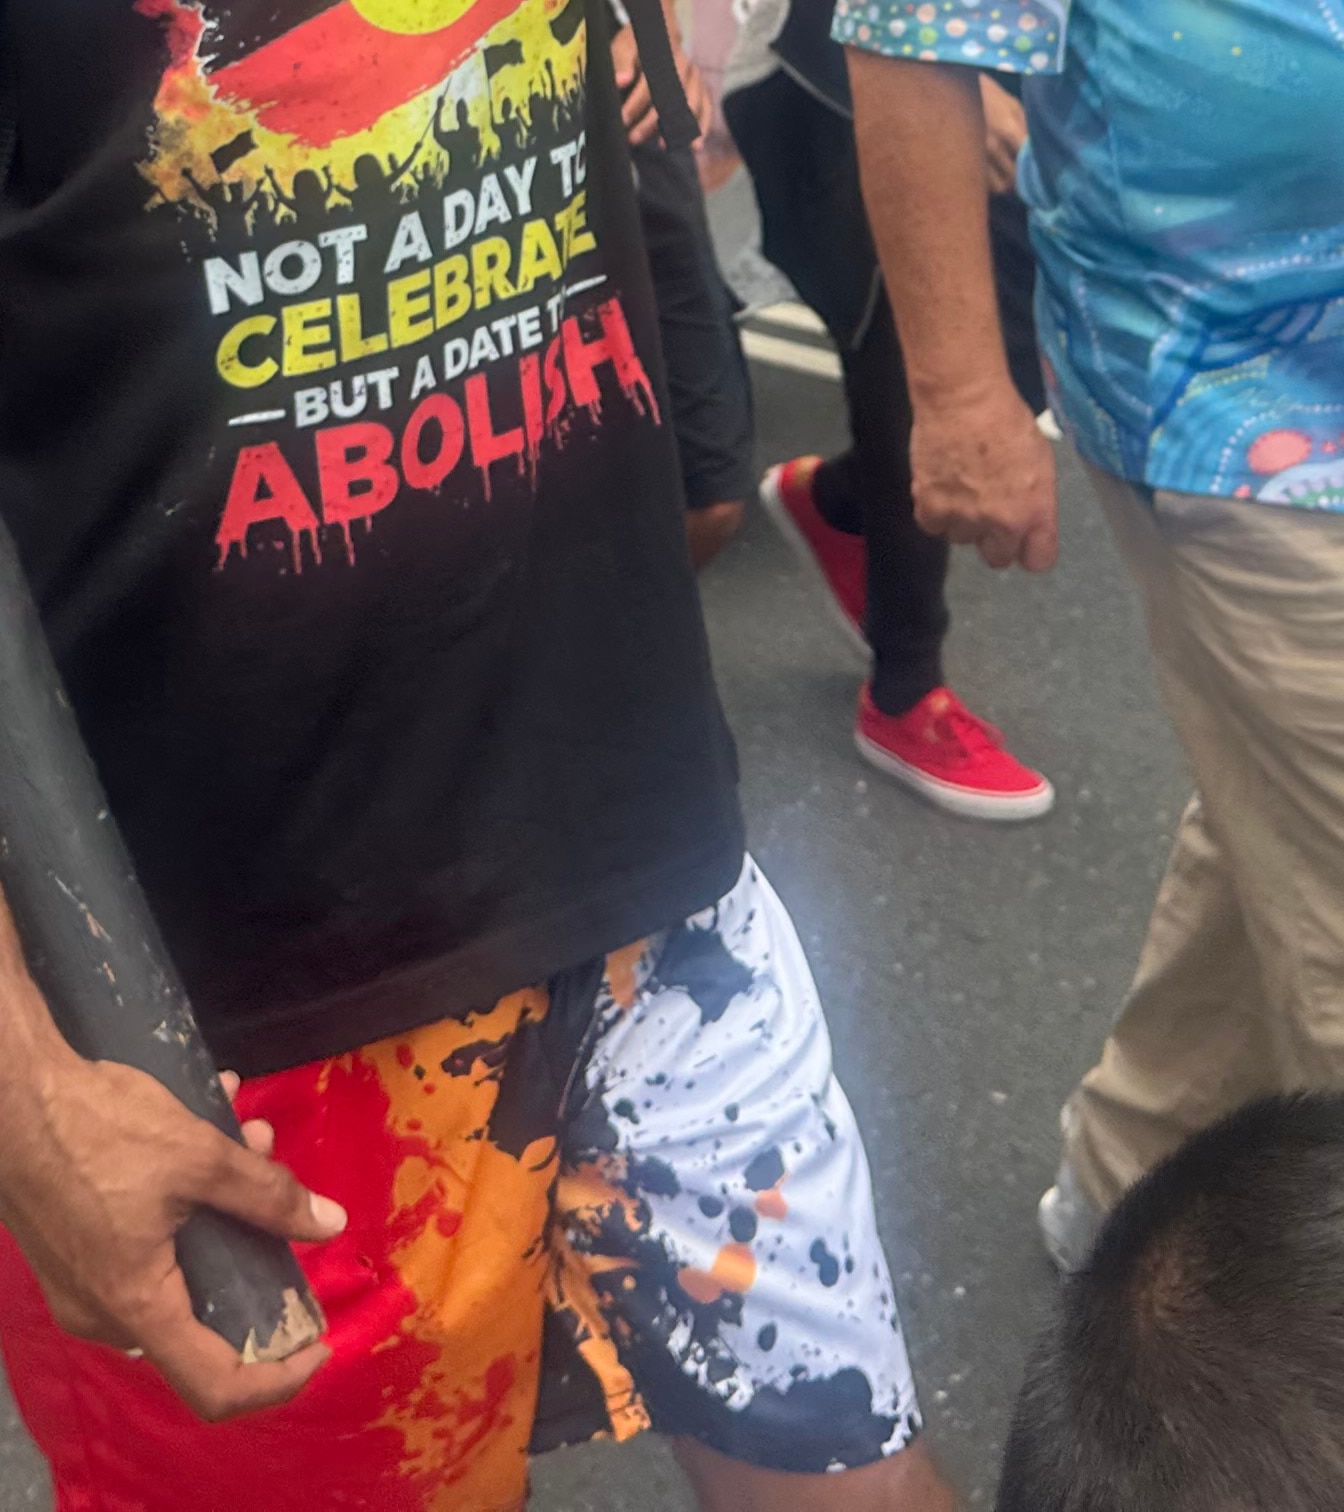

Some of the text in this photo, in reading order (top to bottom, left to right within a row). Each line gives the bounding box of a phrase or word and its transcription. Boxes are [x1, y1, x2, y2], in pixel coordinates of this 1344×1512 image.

[203, 224, 368, 315] NOT
[383, 212, 434, 272] A
[443, 157, 538, 249] DAY
[216, 192, 599, 387] CELEBRATE
[215, 296, 652, 563] ABOLISH
[410, 354, 436, 399] A
[444, 306, 544, 383] DATE
